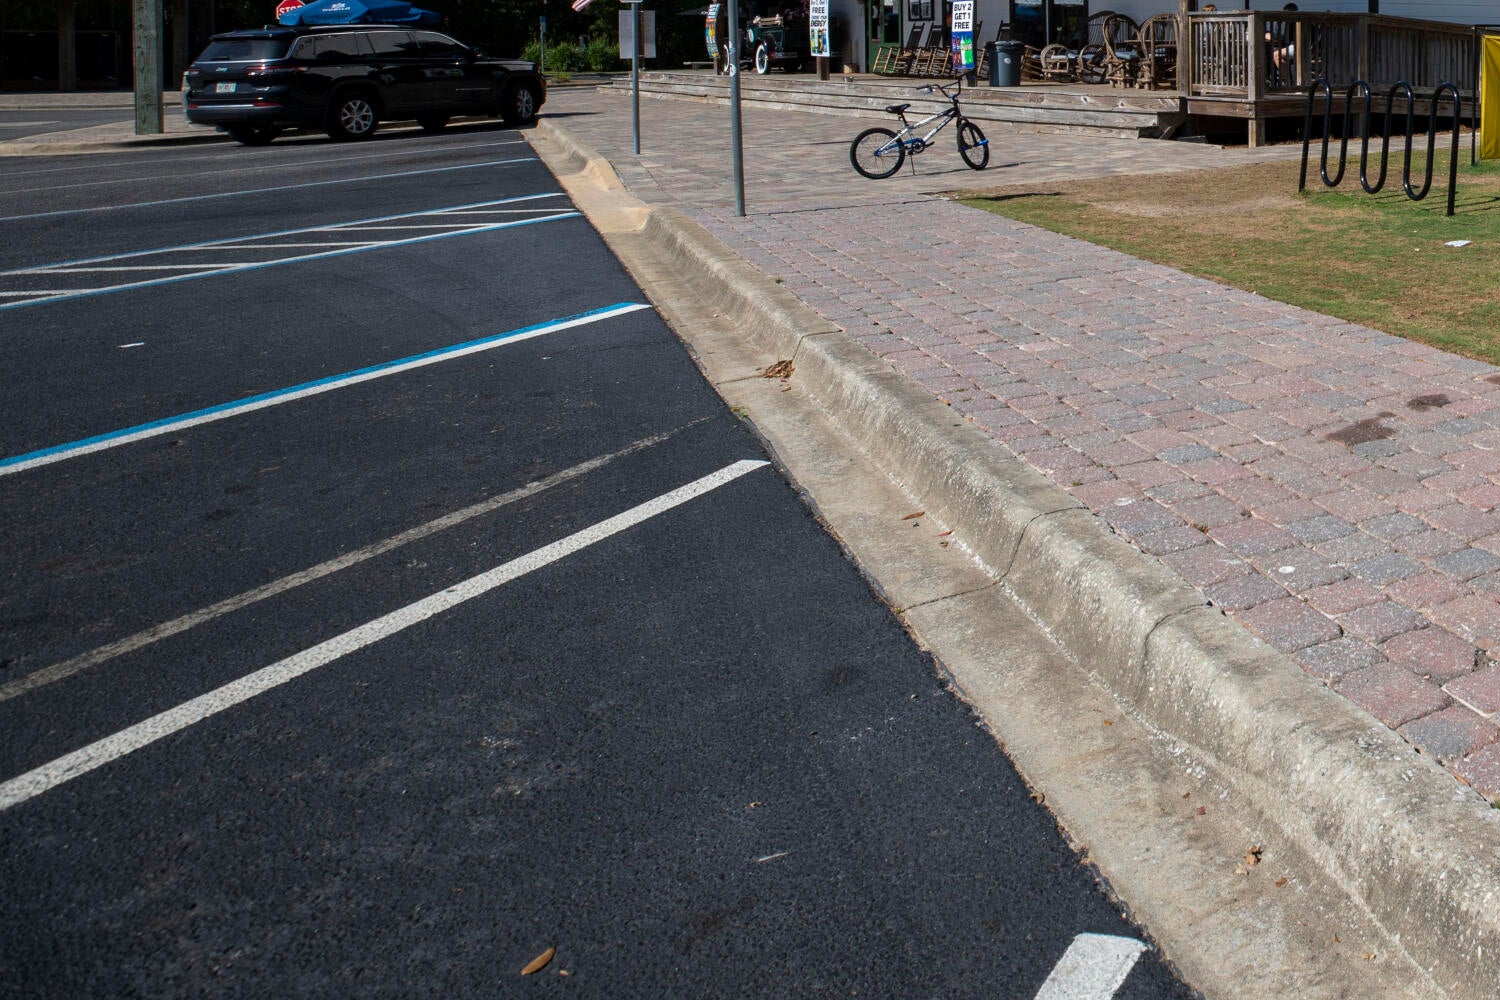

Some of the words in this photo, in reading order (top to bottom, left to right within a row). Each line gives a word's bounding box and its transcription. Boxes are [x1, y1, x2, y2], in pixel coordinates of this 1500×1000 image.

[811, 6, 825, 14] FREE
[967, 2, 972, 10] 2
[279, 5, 304, 16] ST
[954, 12, 967, 20] GET
[954, 21, 970, 29] FREE
